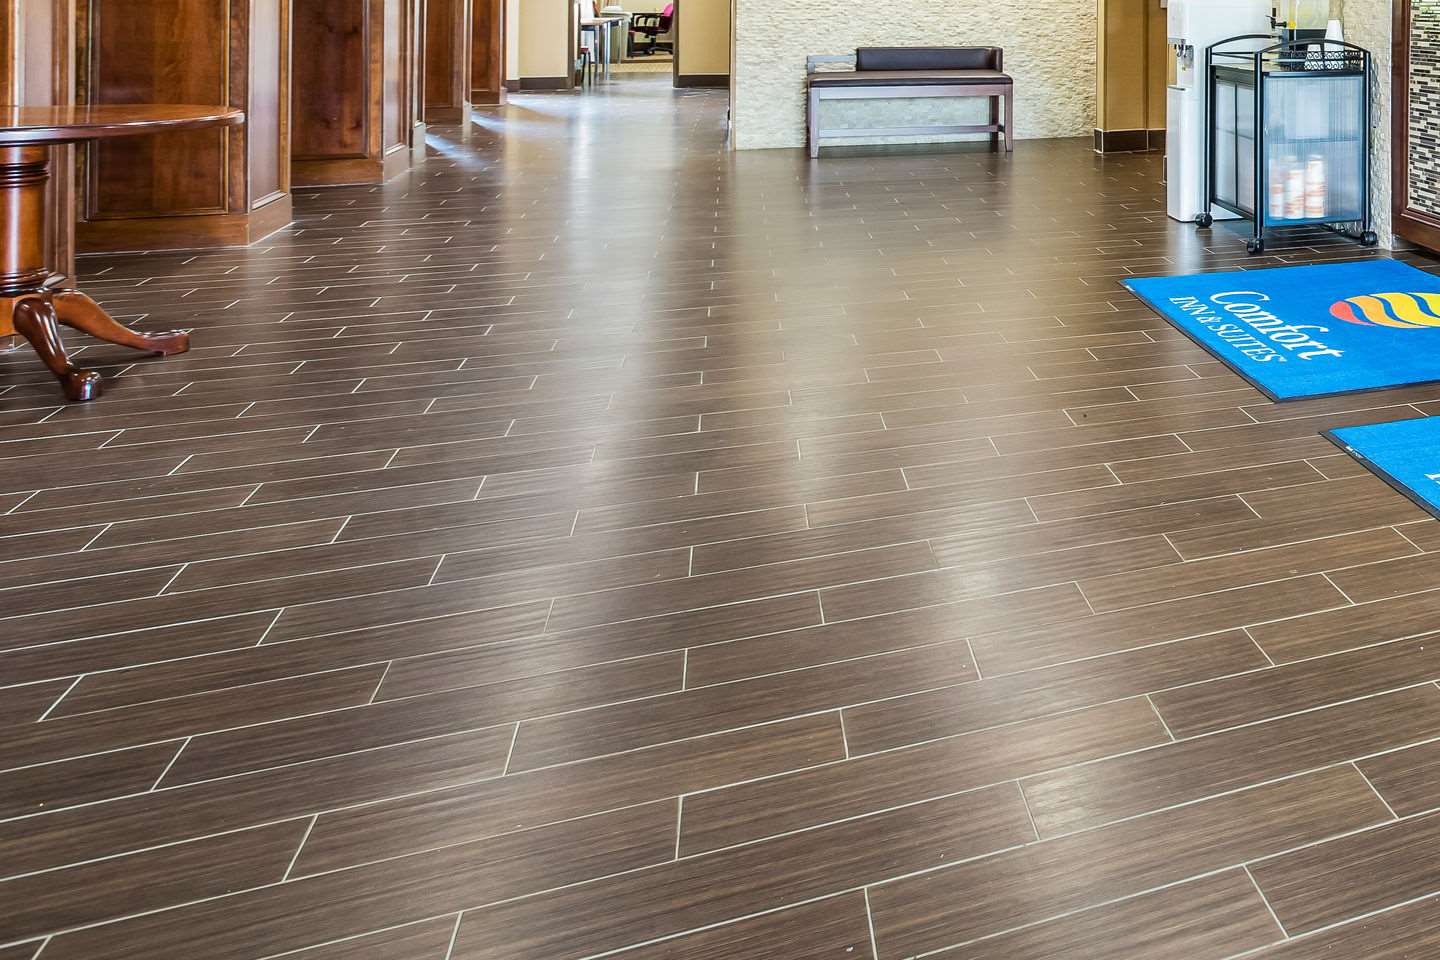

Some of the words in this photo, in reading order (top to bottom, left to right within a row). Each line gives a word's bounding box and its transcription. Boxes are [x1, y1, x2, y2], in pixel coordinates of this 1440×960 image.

[1169, 295, 1210, 317] INN
[1196, 313, 1222, 324] &
[1209, 323, 1283, 363] SUITES
[1209, 290, 1345, 361] Comfort
